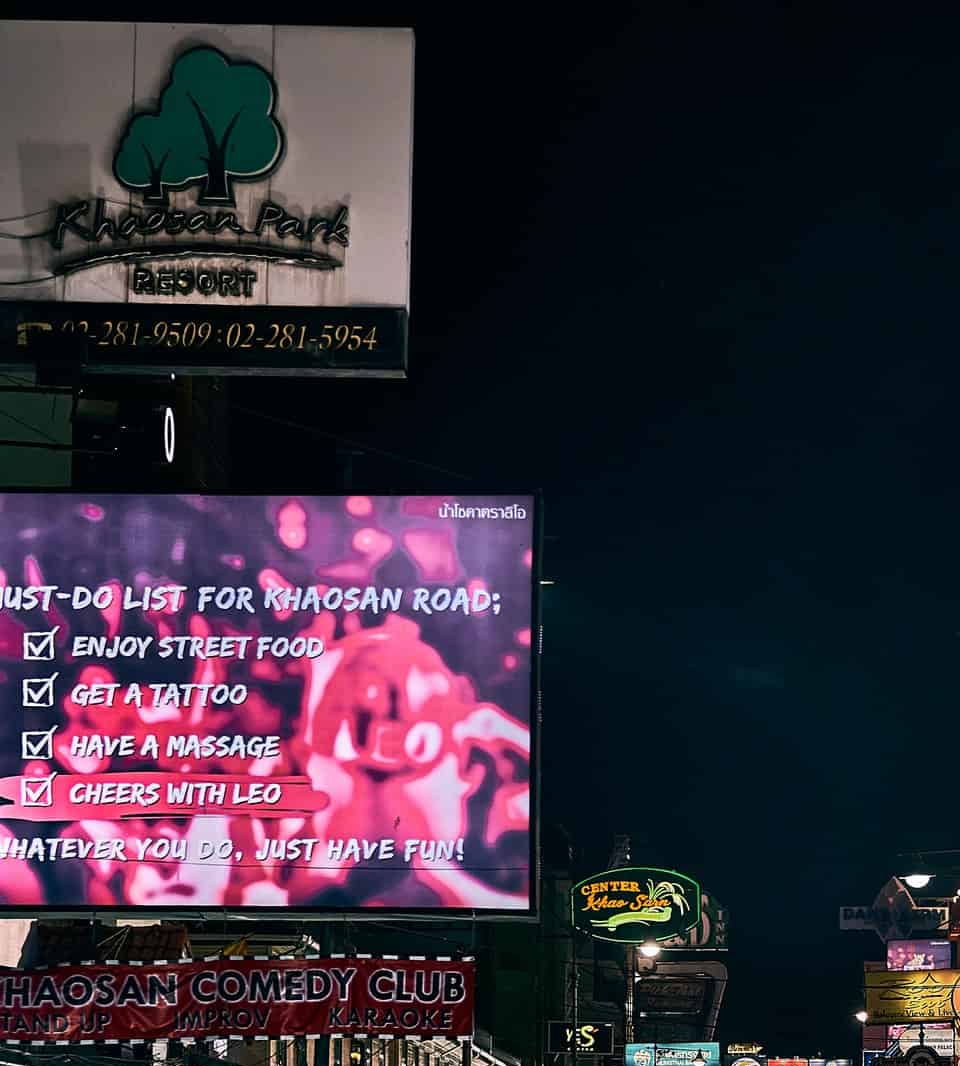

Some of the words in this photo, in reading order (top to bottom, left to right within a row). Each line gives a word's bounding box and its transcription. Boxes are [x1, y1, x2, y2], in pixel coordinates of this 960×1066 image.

[54, 198, 245, 249] Khaosan
[257, 202, 350, 247] Park
[134, 268, 259, 297] RESORT
[0, 586, 113, 611] UST-DO
[123, 587, 187, 611] LIST
[198, 587, 255, 613] FOR
[264, 588, 403, 613] KHAOSAN
[412, 588, 502, 614] ROAD;
[72, 636, 153, 658] ENJOY
[158, 636, 252, 660] STREET
[256, 637, 323, 659] FOOD
[71, 684, 120, 706] GET
[124, 683, 143, 702] A
[151, 684, 248, 708] TATTOO
[71, 735, 135, 758] HAVE
[140, 736, 160, 758] A
[166, 735, 281, 758] MASSAGE
[69, 783, 160, 806] CHEERS
[167, 783, 226, 806] WITH
[232, 783, 282, 806] LEO
[136, 838, 188, 863] YOU
[199, 840, 243, 863] DO,
[255, 839, 320, 863] JUST
[327, 839, 394, 861] HAVE
[405, 839, 466, 862] FUN!
[580, 880, 641, 896] CENTER
[580, 893, 628, 912] Khao
[0, 974, 178, 1008] HAOSAN
[190, 967, 357, 1004] COMEDY
[368, 968, 467, 1004] CLUB
[79, 1012, 113, 1034] UP
[173, 1008, 273, 1032] IMPROV
[328, 1007, 454, 1030] KARAOKE
